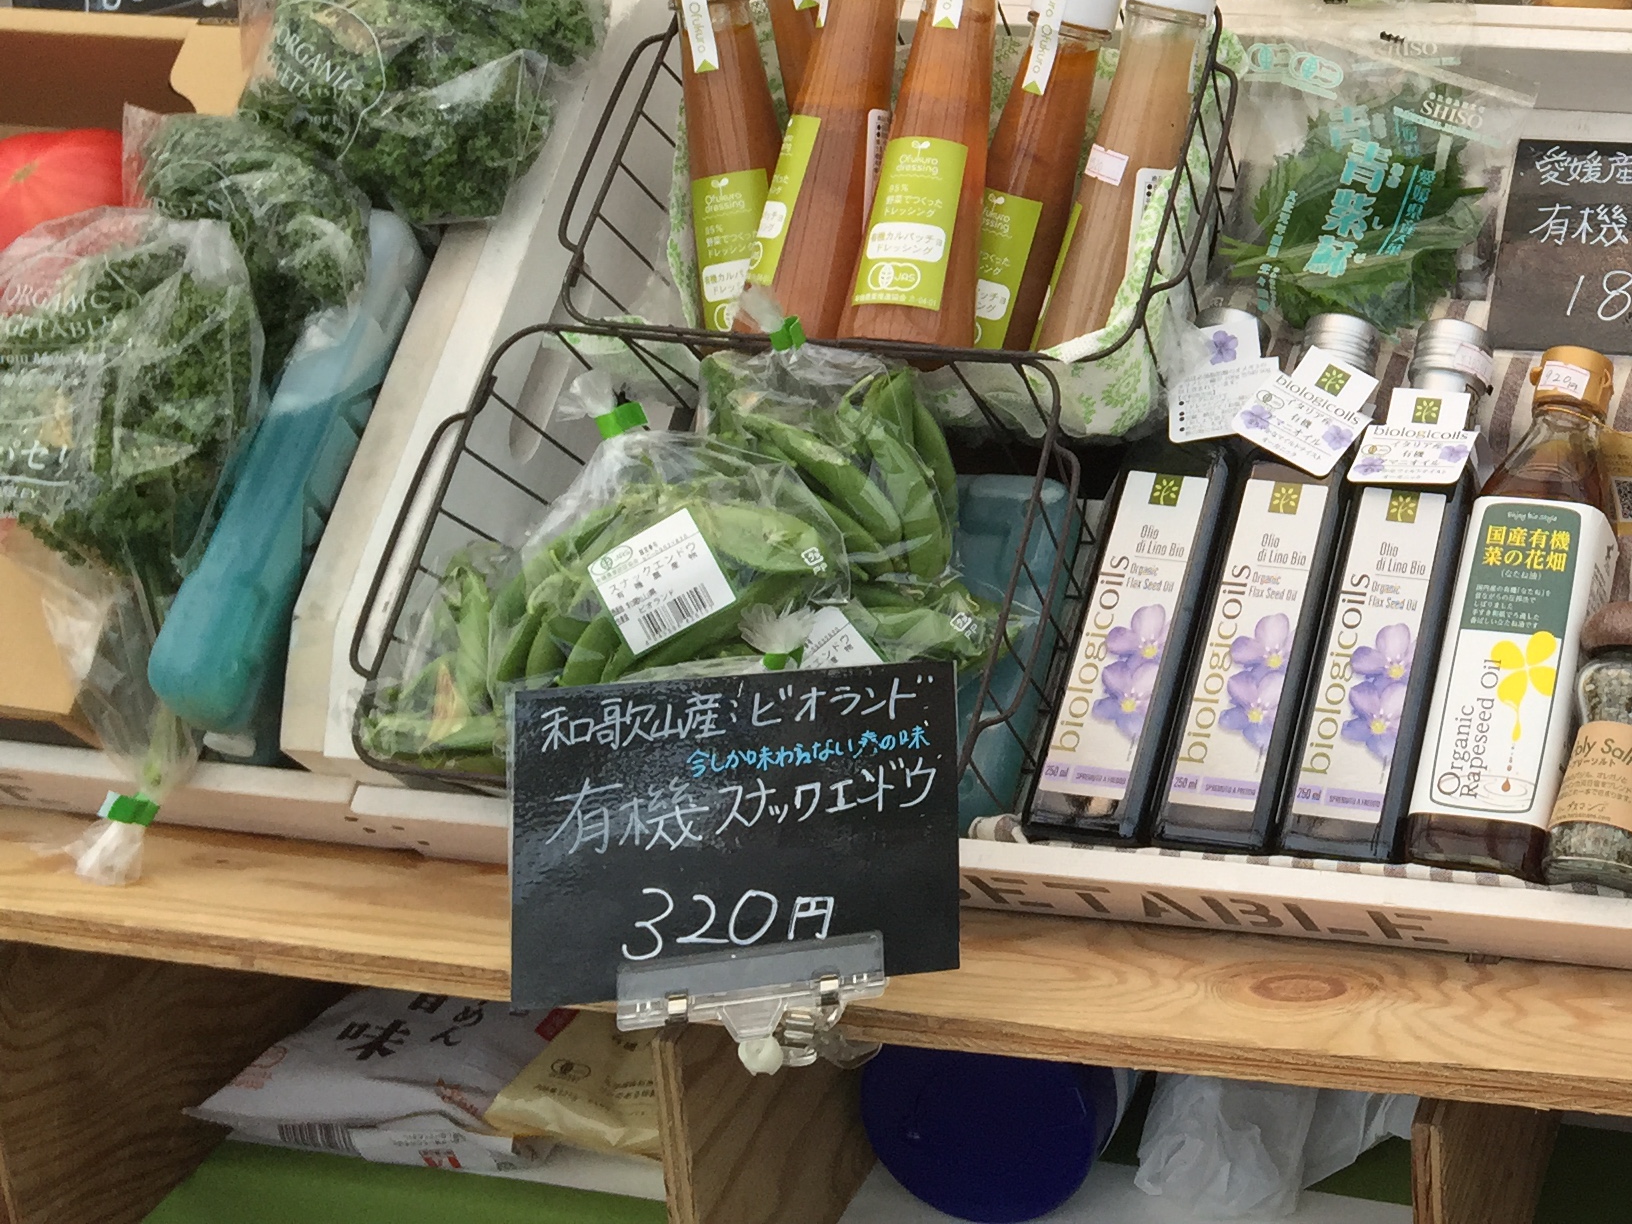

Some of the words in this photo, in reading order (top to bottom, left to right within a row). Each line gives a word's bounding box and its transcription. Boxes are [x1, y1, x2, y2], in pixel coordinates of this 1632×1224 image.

[689, 2, 706, 53] Ofukuro
[1032, 24, 1053, 74] Ofukuro
[1420, 100, 1483, 129] SHISO
[1276, 374, 1361, 426] biologicoils
[1373, 425, 1469, 440] biologicoils
[1140, 525, 1159, 540] Olio
[1261, 533, 1279, 548] Olio
[1485, 525, 1571, 552] 国産有機
[1136, 540, 1145, 554] di
[1146, 541, 1167, 556] Lino
[1169, 543, 1184, 557] Bio
[1257, 548, 1266, 562] di
[1268, 549, 1288, 564] Lino
[1290, 552, 1306, 566] Bio
[1380, 542, 1398, 557] Olio
[1375, 557, 1384, 571] di
[1386, 558, 1407, 573] Lino
[1409, 561, 1425, 575] Bio
[1482, 546, 1568, 572] 菜の花畑
[1130, 562, 1159, 578] Organic
[1252, 572, 1280, 586] Organic
[1125, 576, 1141, 588] Flax
[1371, 580, 1401, 595] Organic
[1249, 586, 1265, 598] Flax
[1368, 595, 1384, 608] Flax
[1051, 554, 1130, 753] biologicoils
[1178, 564, 1251, 764] biologicoils
[1302, 573, 1370, 774] biologicoils
[1460, 698, 1495, 799] Rapeseed
[1480, 659, 1502, 690] Oil
[1437, 705, 1475, 796] Organic
[621, 888, 836, 961] 320円
